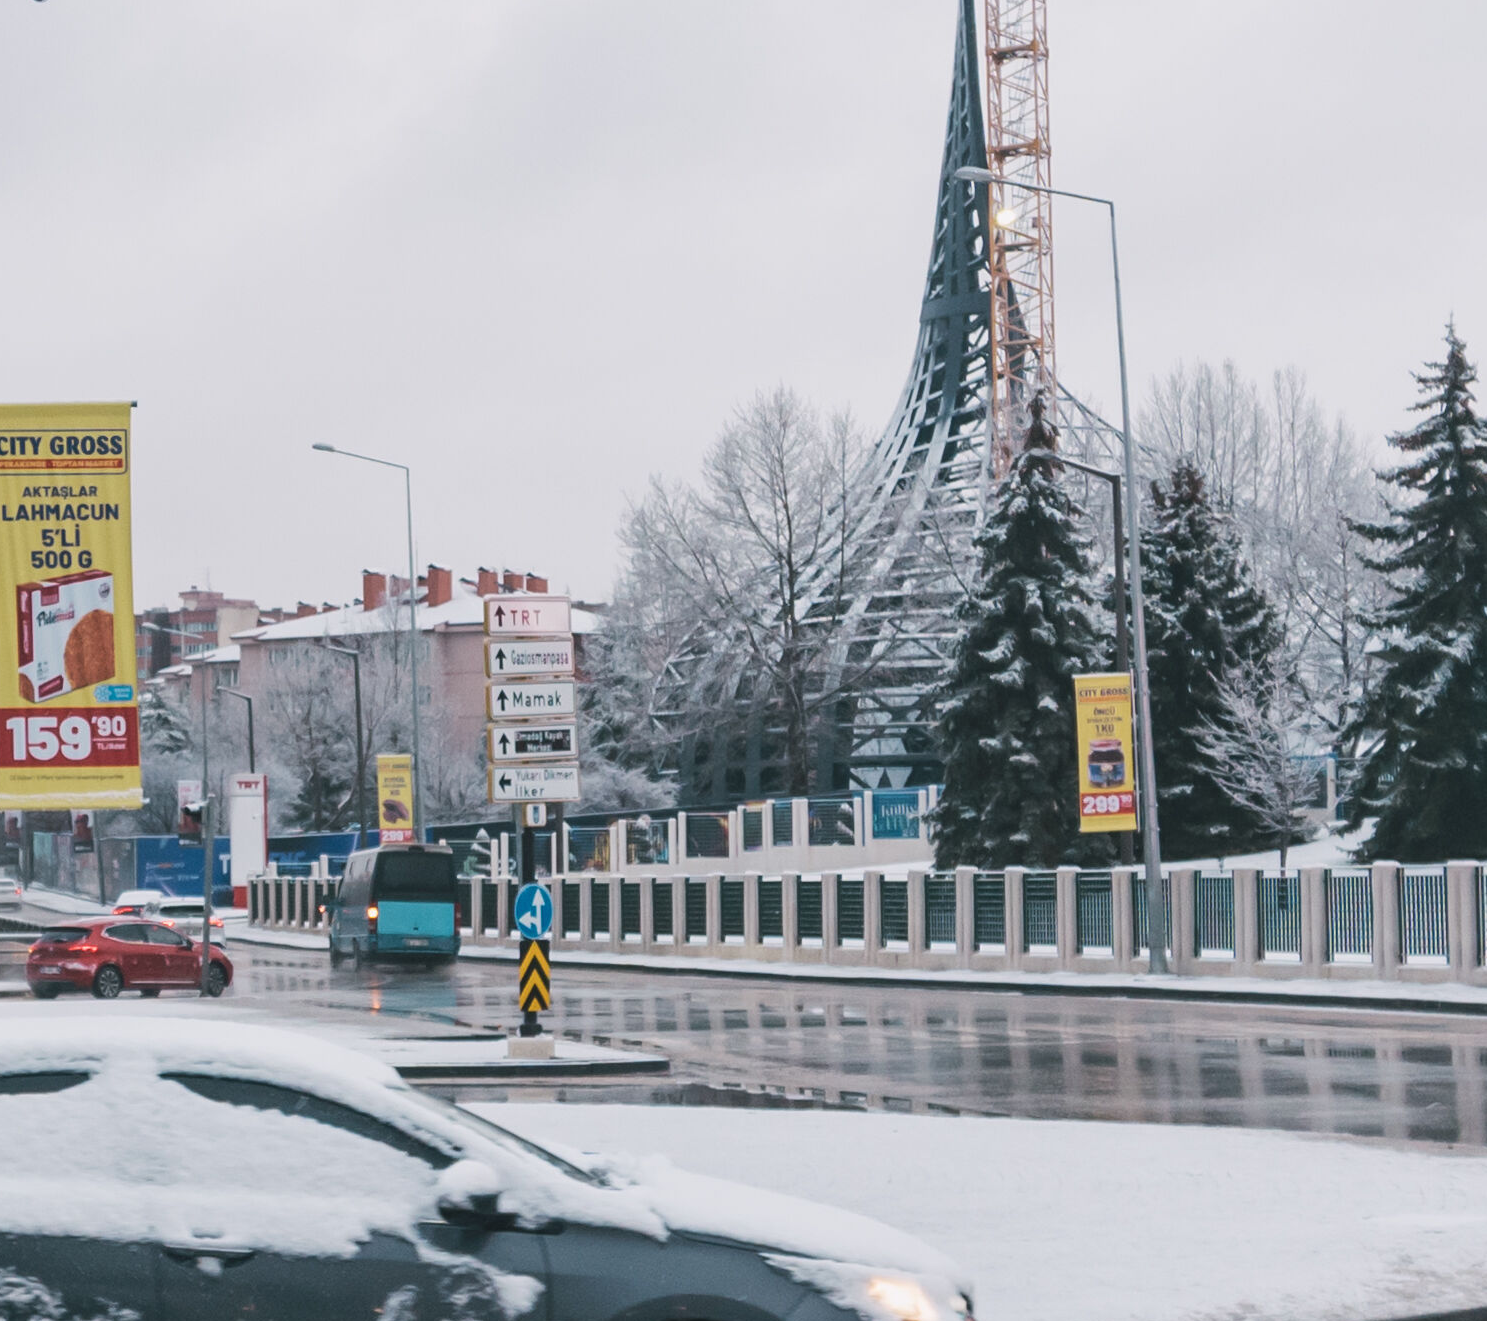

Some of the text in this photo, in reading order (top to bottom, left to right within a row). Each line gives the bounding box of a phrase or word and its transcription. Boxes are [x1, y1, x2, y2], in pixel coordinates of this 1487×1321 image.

[49, 435, 123, 456] GROSS
[22, 486, 98, 500] AKTAŞLAR
[1, 503, 119, 521] LAHMACUN
[30, 550, 93, 569] 500 G
[510, 610, 541, 626] TRT
[512, 689, 562, 708] Mamak
[236, 780, 260, 790] TRT
